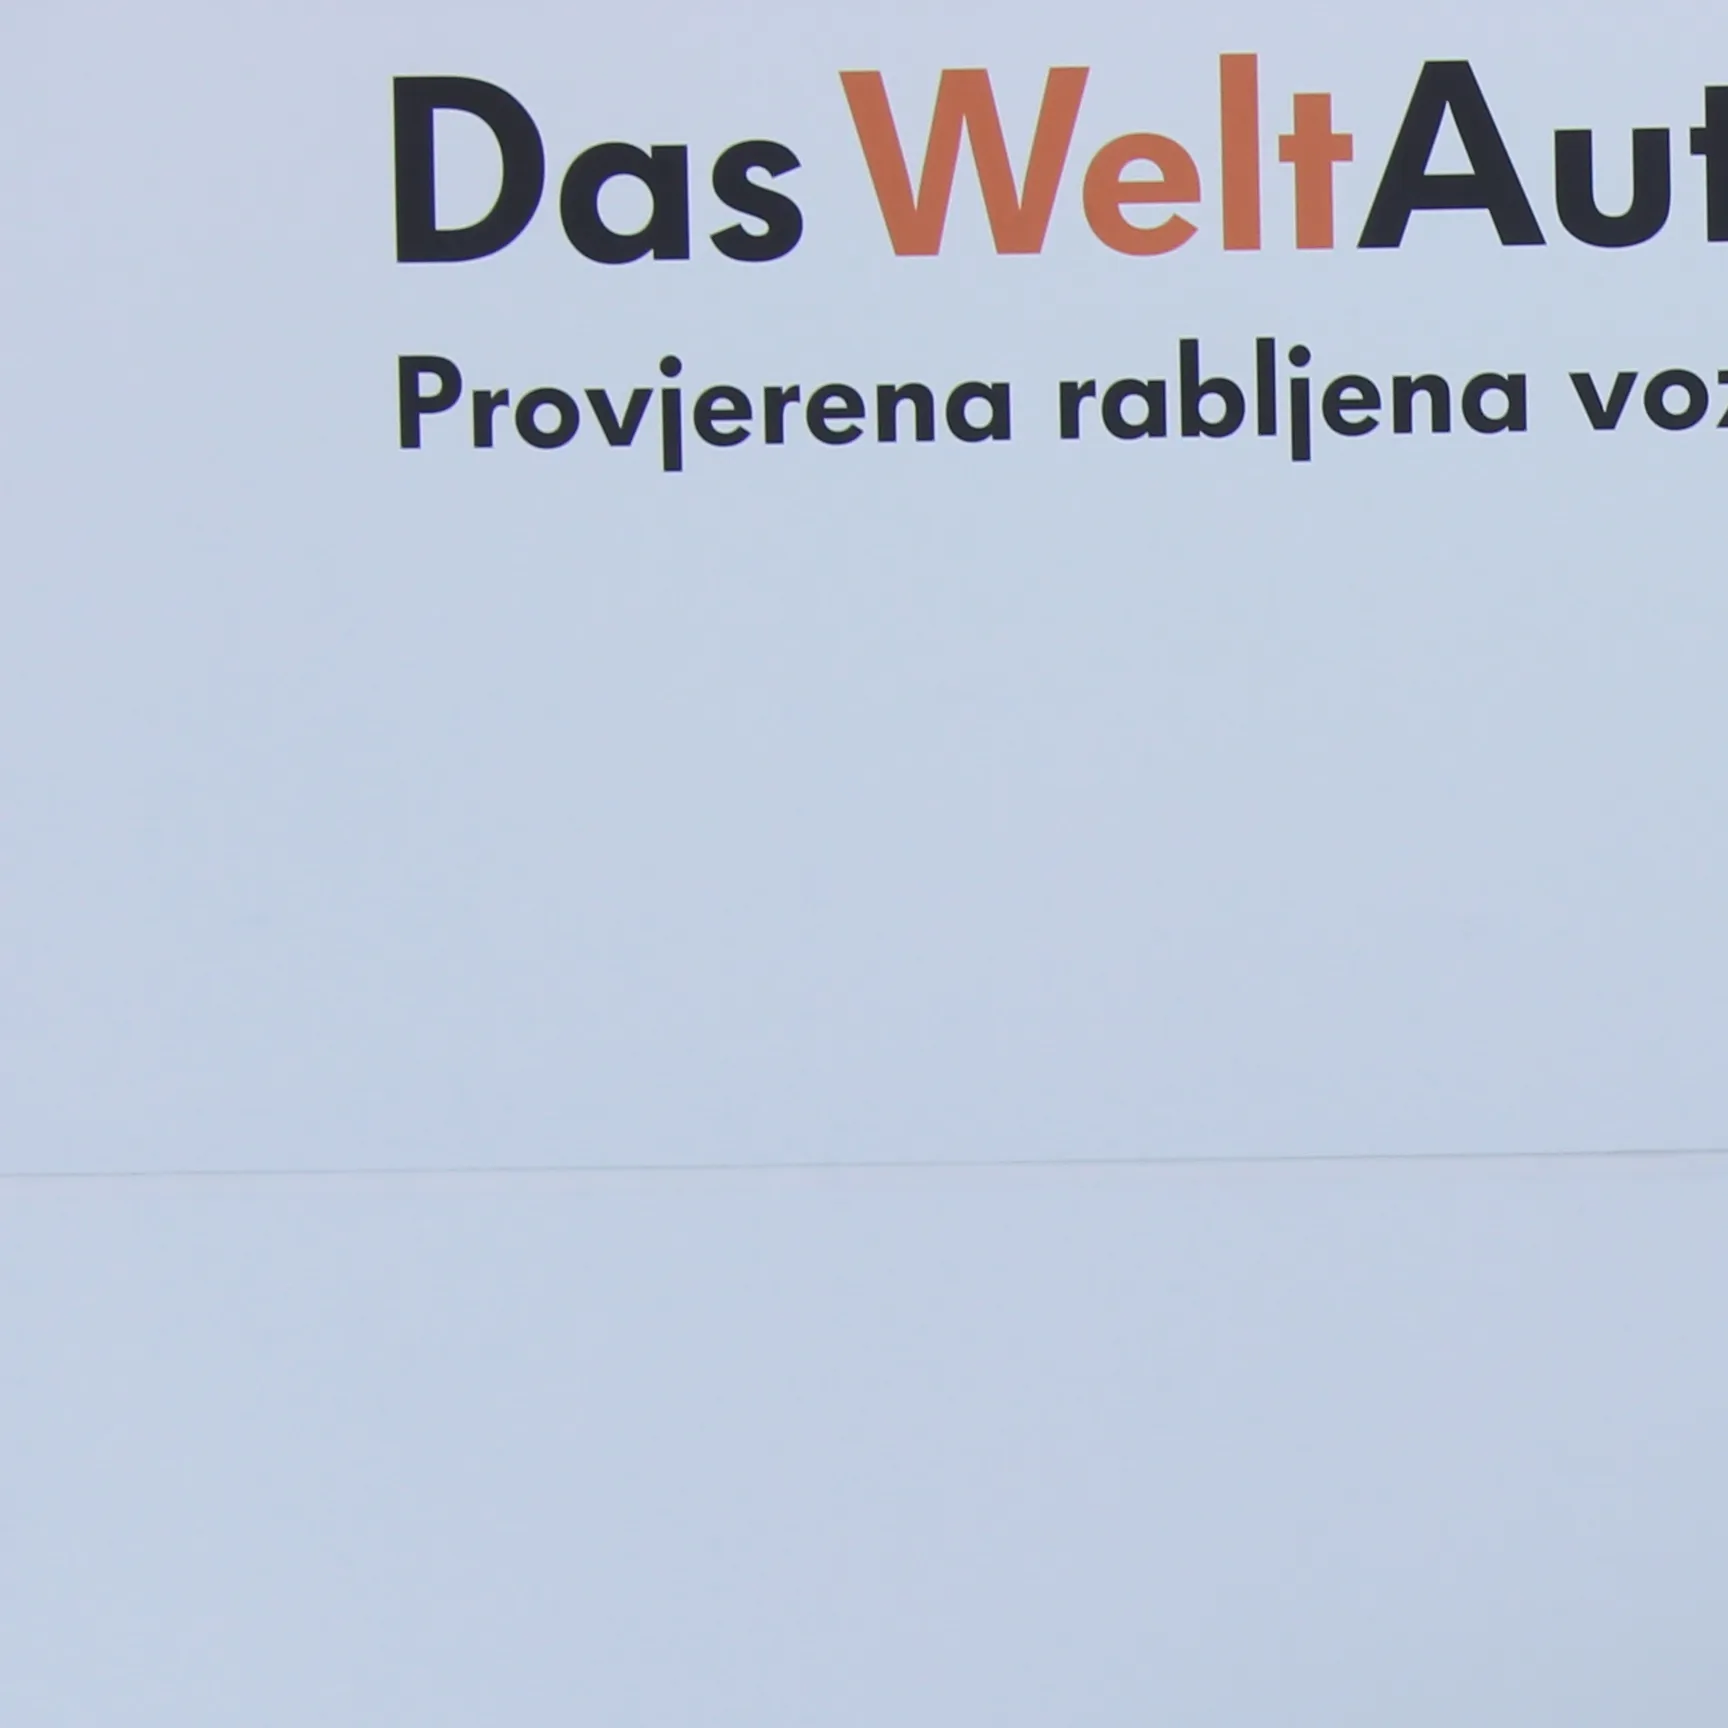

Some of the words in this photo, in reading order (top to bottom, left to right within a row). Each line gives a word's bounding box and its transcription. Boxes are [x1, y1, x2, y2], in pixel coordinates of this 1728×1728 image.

[393, 76, 803, 264] Das
[399, 355, 1010, 472] Provjerena
[1060, 337, 1527, 461] rabljena
